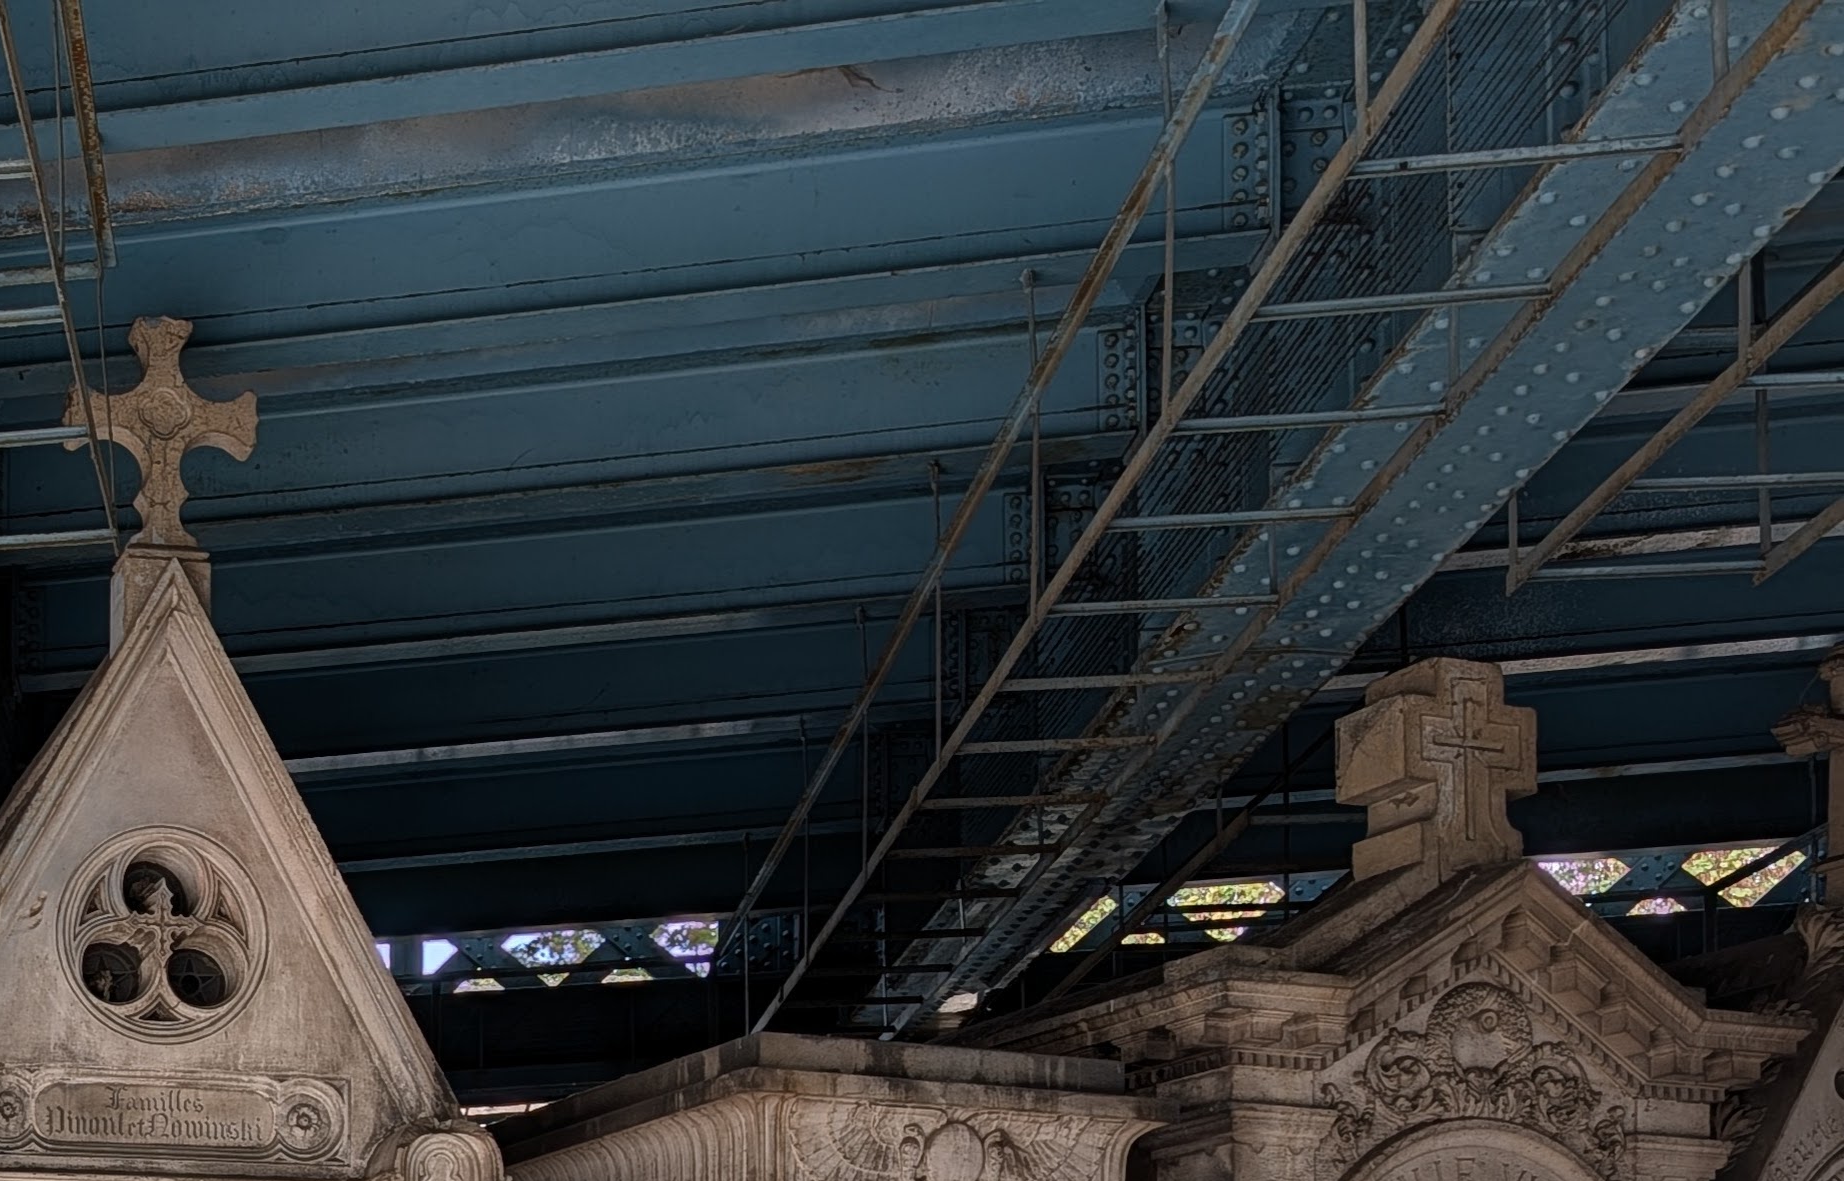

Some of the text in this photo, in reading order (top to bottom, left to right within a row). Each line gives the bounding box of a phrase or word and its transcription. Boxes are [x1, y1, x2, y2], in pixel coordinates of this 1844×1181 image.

[106, 1086, 205, 1115] Familles
[127, 1117, 144, 1138] et
[144, 1112, 264, 1142] Nowinski
